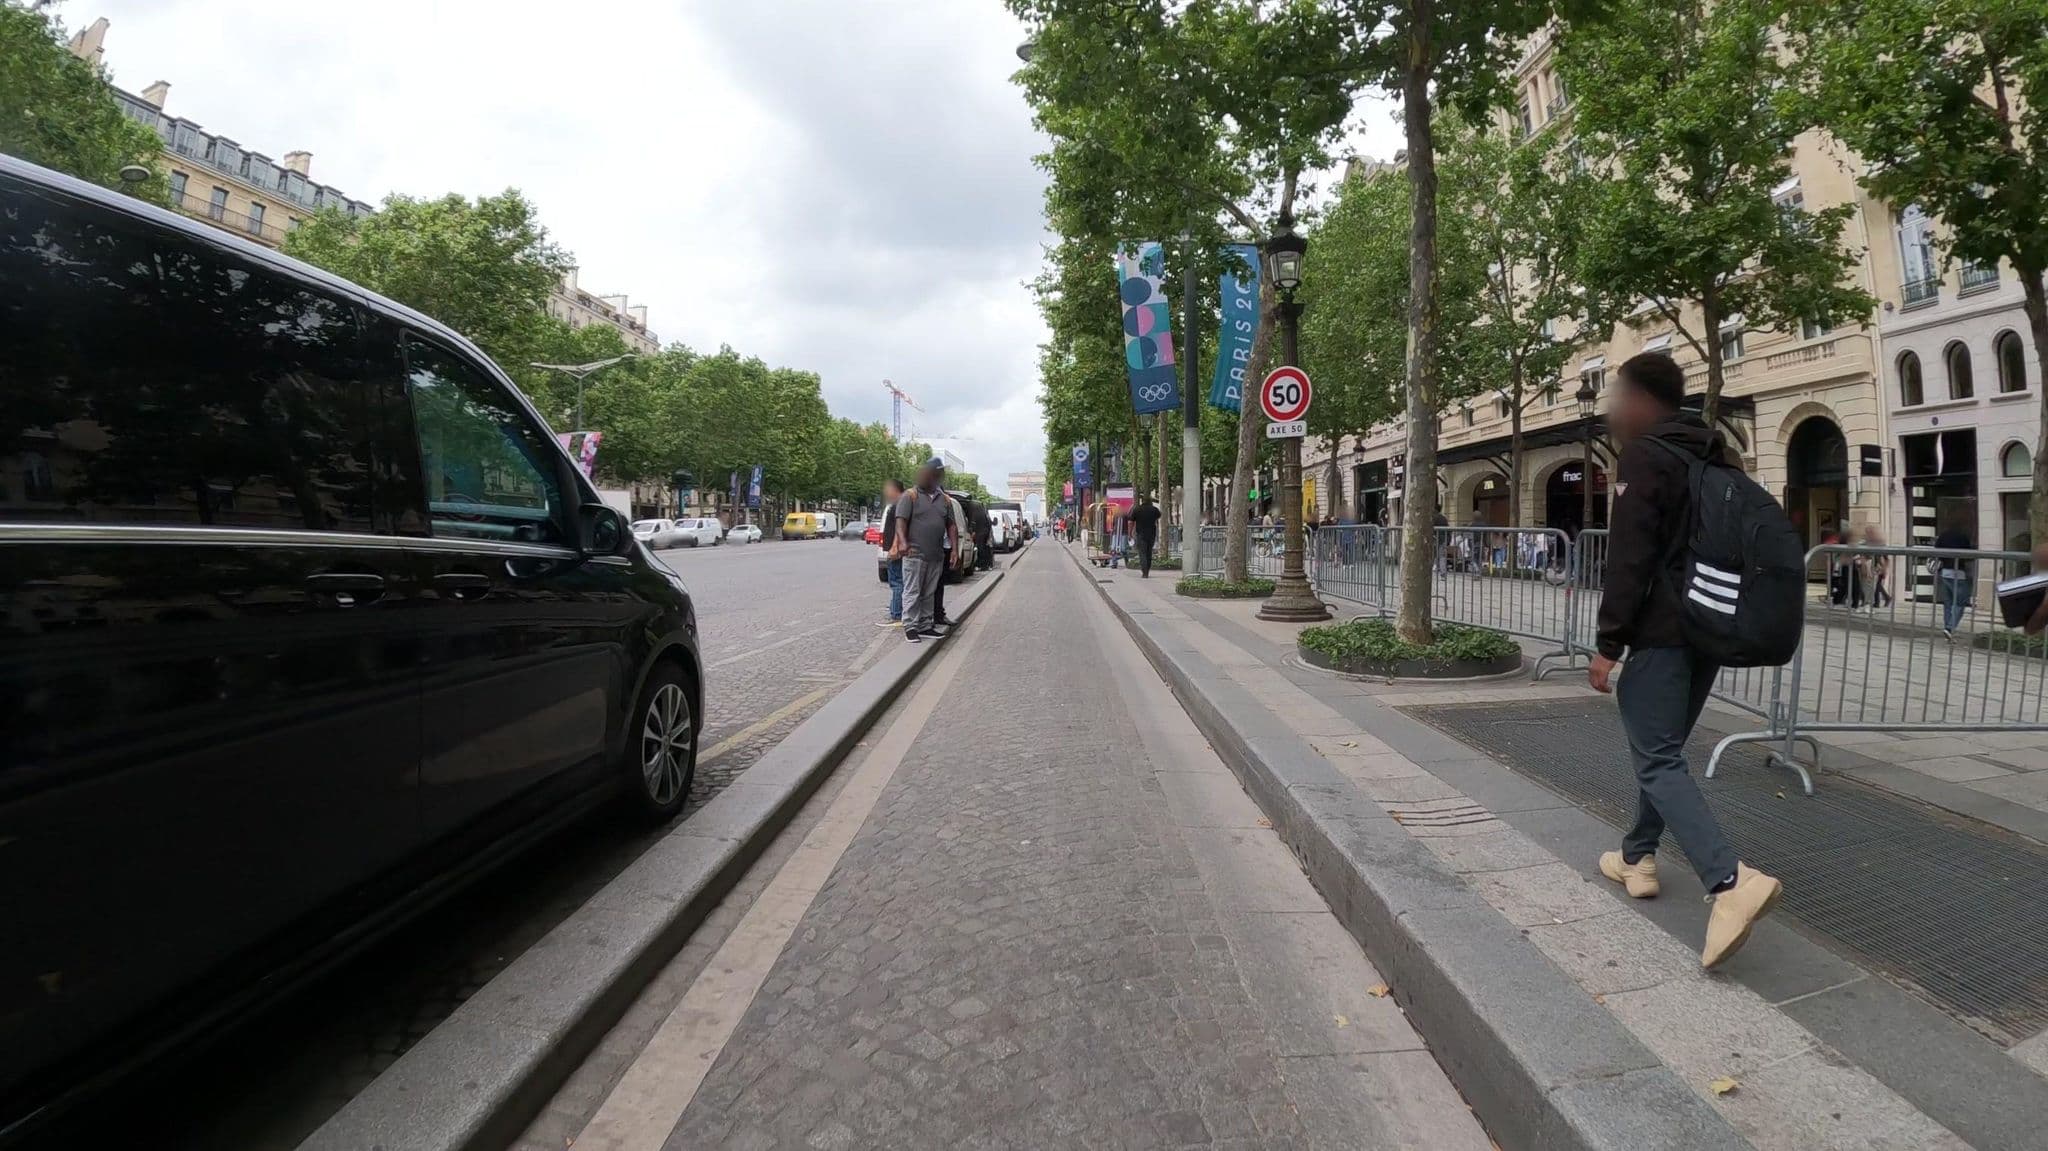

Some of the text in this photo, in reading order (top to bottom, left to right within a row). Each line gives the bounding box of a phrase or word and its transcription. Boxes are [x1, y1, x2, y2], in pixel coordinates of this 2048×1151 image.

[1272, 384, 1300, 407] 50
[1270, 425, 1303, 435] AXE 50
[1563, 471, 1582, 482] fnac
